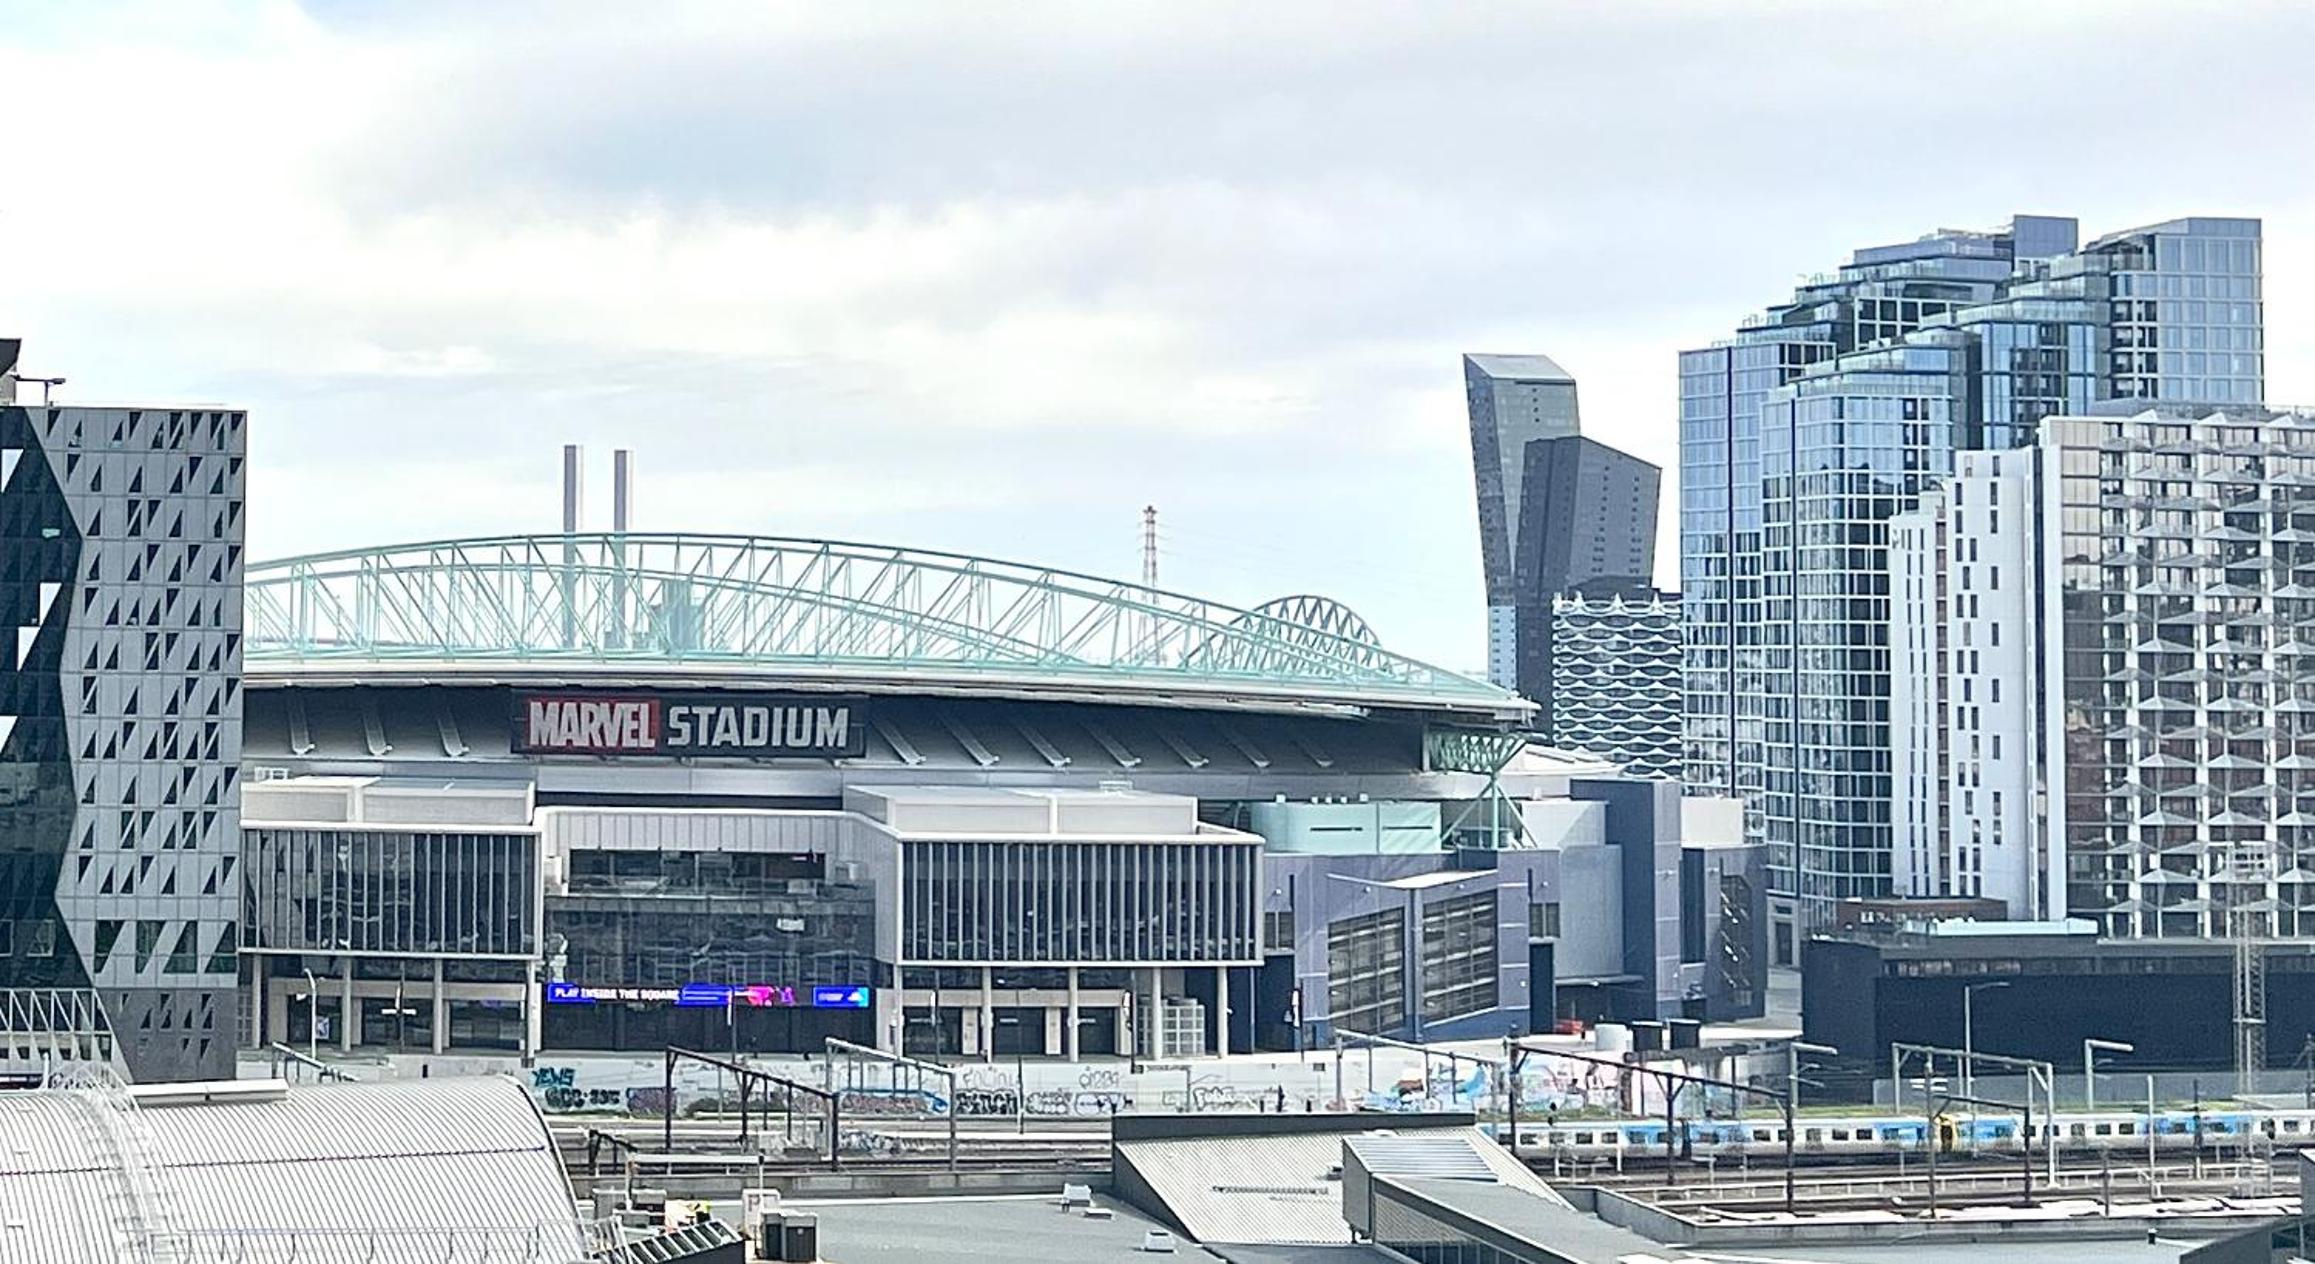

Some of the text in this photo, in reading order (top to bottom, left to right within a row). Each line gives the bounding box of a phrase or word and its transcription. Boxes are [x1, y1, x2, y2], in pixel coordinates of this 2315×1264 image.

[529, 701, 850, 748] MARVEL STADIUM
[555, 987, 579, 998] PLAY
[581, 987, 617, 999] INSIDE
[619, 988, 638, 1000] THE
[640, 988, 680, 1001] SQUARE
